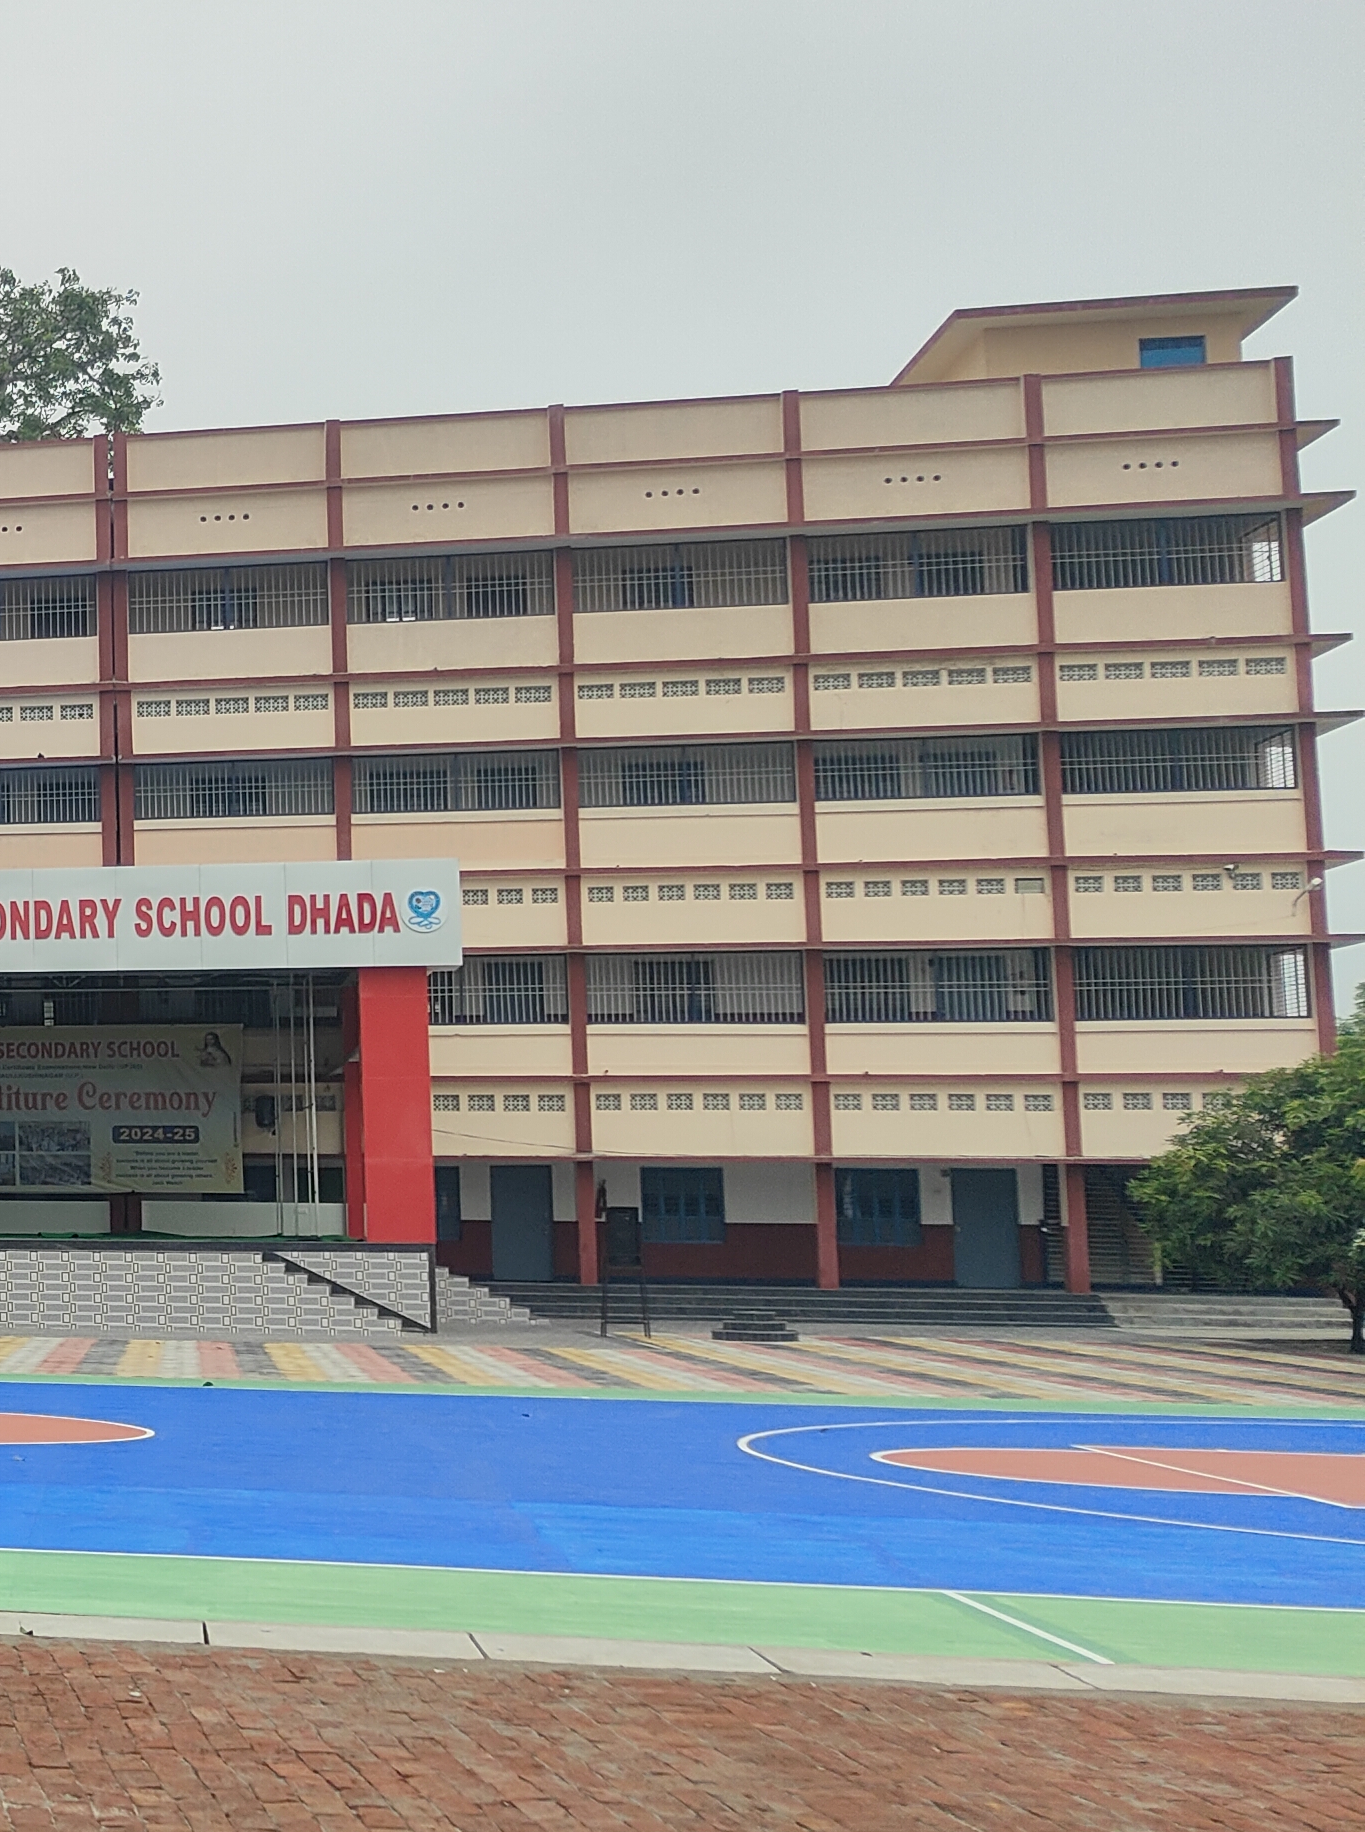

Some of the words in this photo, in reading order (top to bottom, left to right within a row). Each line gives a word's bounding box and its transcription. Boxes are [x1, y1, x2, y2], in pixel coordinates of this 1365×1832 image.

[135, 894, 274, 939] SCHOOL
[287, 891, 401, 936] DHADA
[106, 1040, 180, 1058] SCHOOL
[77, 1081, 217, 1118] Ceremony
[119, 1127, 196, 1141] 2024-25
